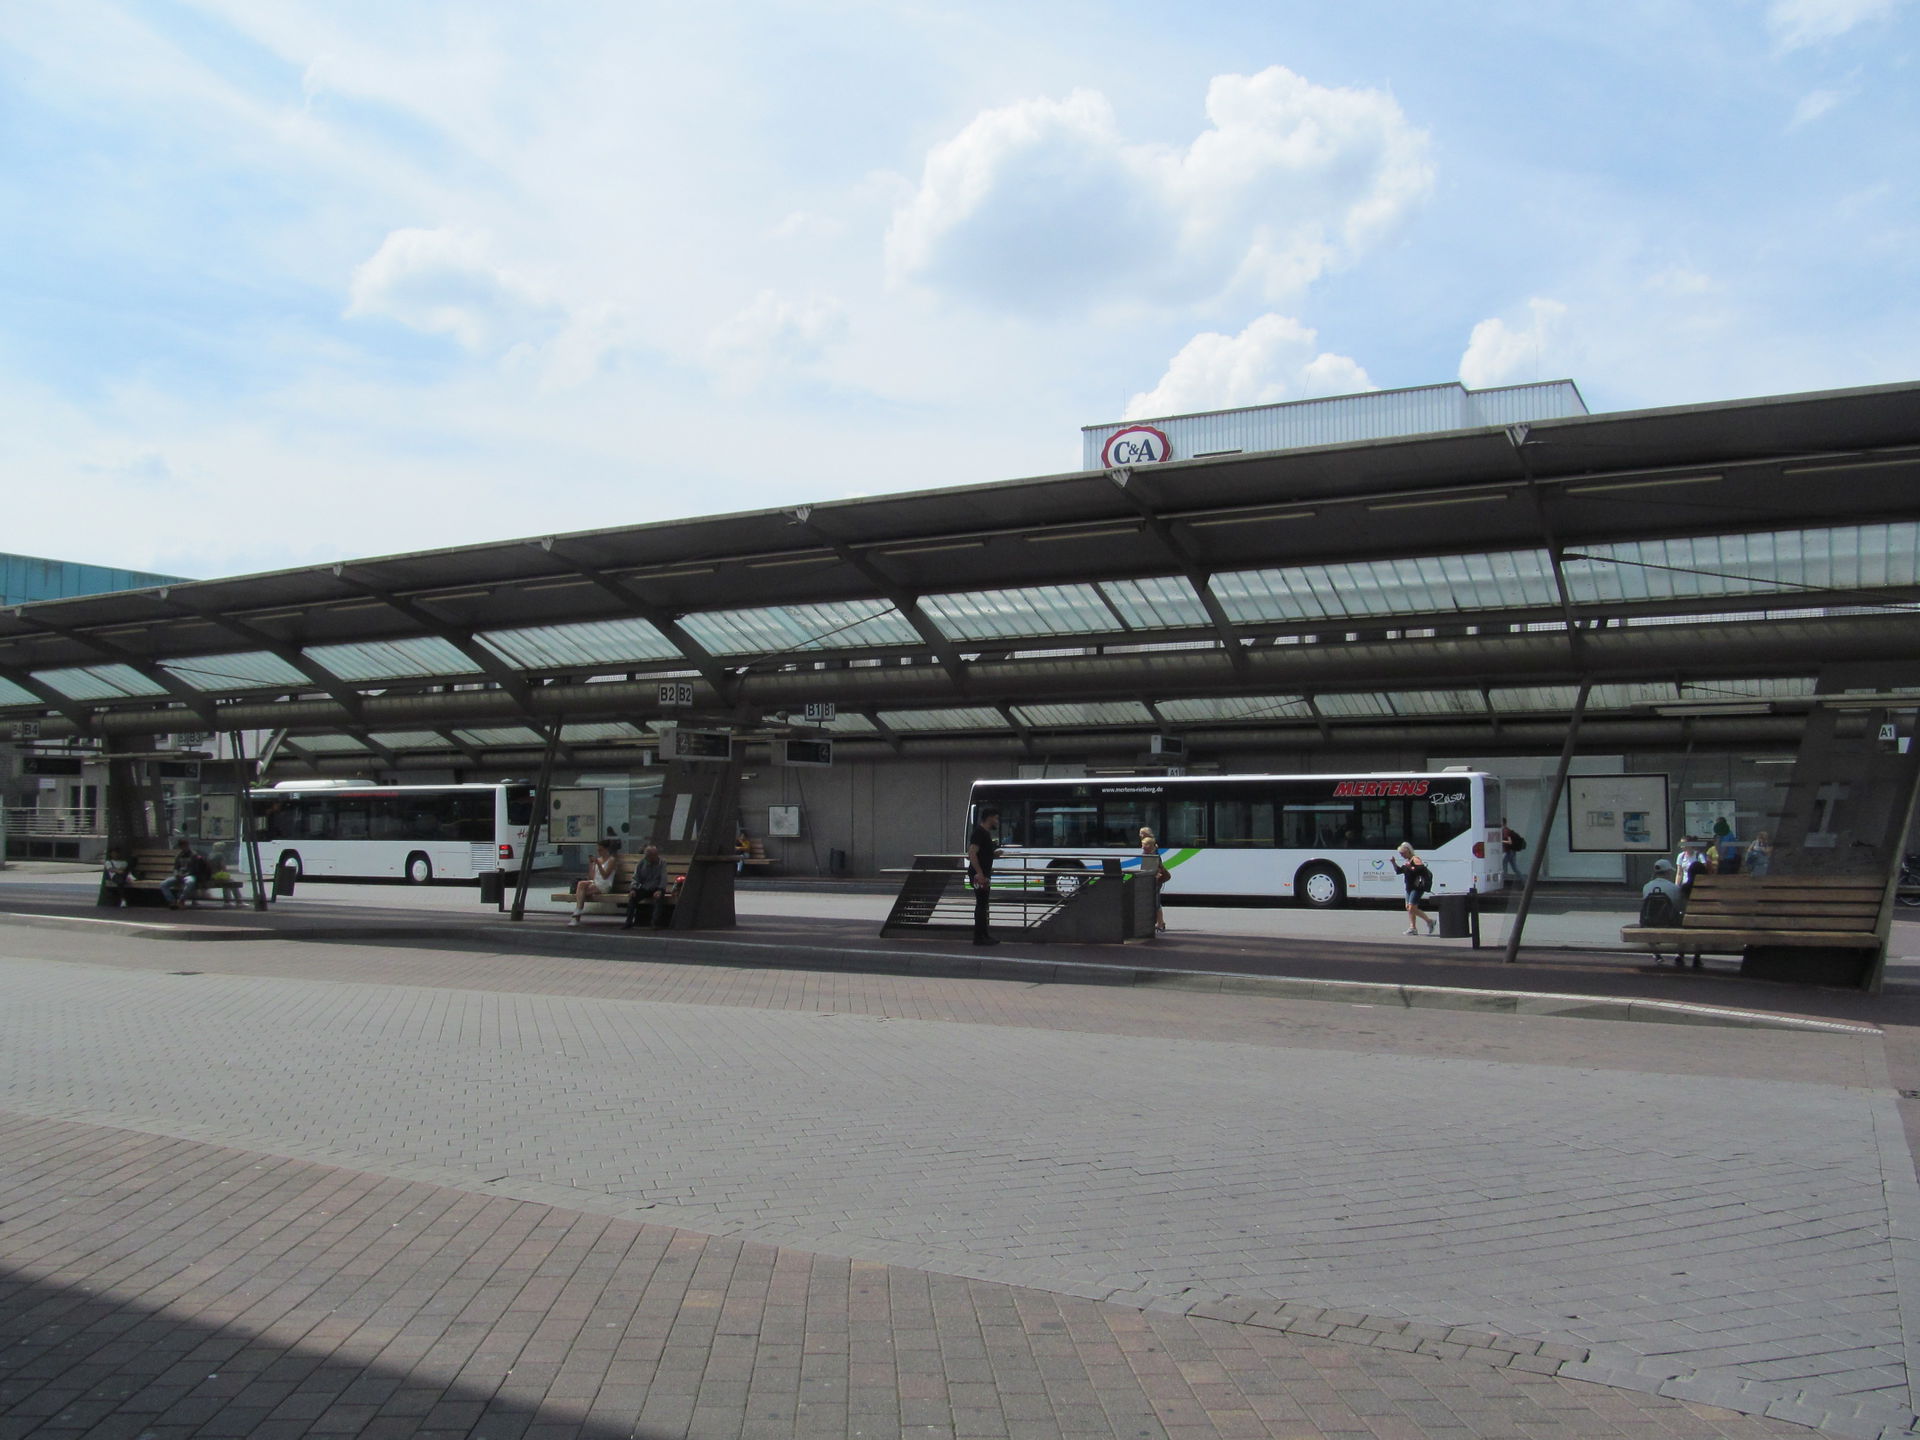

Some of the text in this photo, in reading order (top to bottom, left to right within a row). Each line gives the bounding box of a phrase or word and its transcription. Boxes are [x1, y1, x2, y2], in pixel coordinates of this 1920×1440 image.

[1113, 438, 1158, 465] C&A
[660, 686, 675, 702] B2
[679, 687, 692, 702] B2
[807, 703, 821, 717] B1
[823, 703, 834, 717] B1
[24, 722, 38, 736] B4
[1880, 727, 1893, 738] A1
[1333, 780, 1431, 797] MERTENS
[1429, 792, 1466, 806] Reisen
